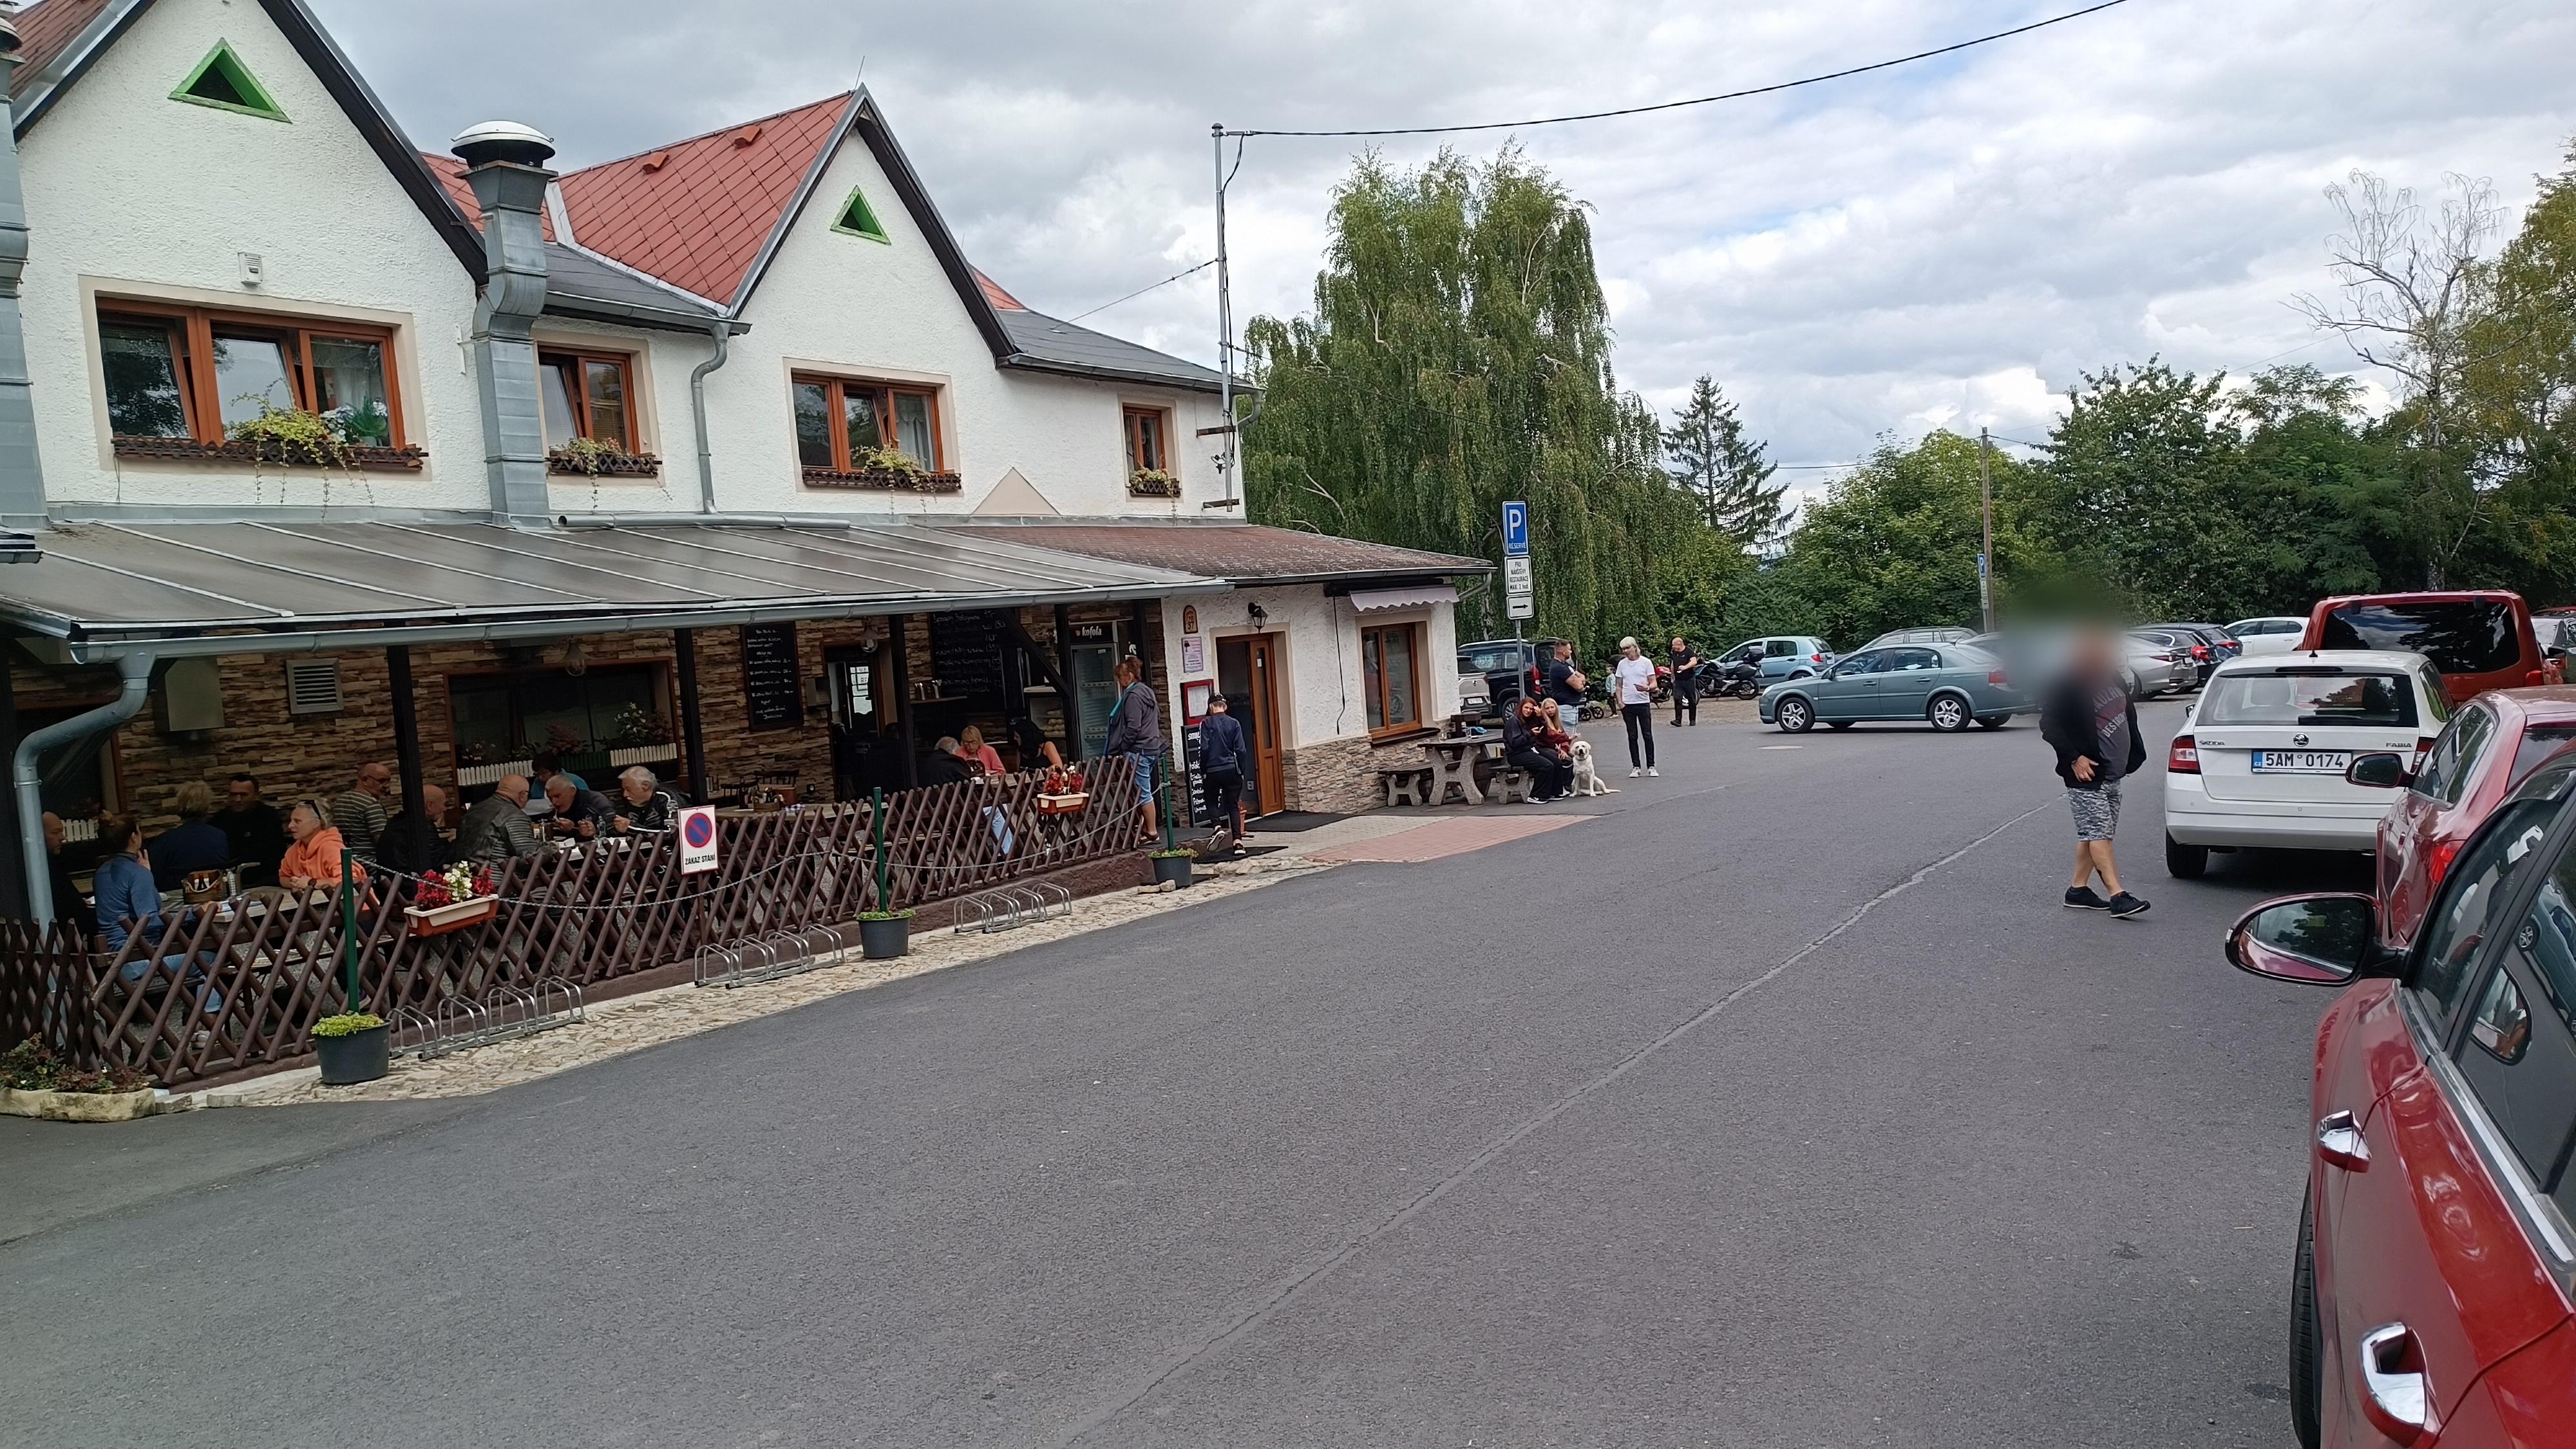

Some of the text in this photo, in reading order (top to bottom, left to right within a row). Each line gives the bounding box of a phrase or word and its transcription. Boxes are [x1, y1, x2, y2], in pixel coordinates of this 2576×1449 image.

[1509, 509, 1522, 539] P
[1980, 556, 1984, 571] P
[1082, 625, 1103, 639] kofola
[2266, 753, 2344, 768] 5AM 0174
[685, 856, 701, 865] ZÁKAZ
